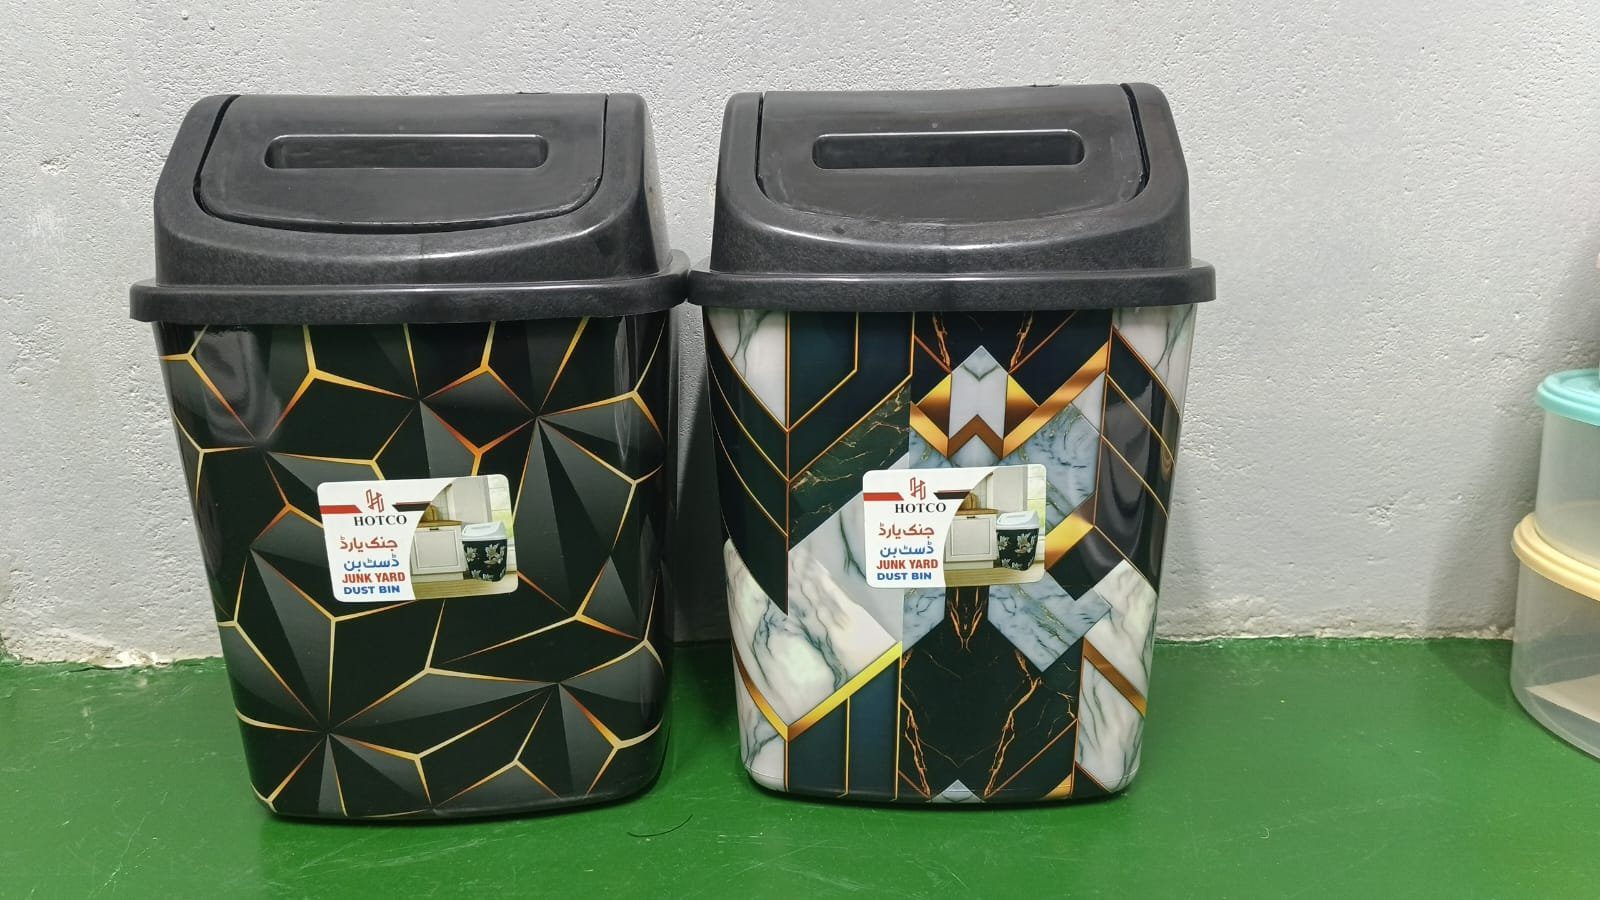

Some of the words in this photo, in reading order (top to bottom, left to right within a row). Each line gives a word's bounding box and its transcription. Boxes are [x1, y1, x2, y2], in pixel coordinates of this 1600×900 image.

[895, 502, 947, 514] HOTCO
[353, 514, 408, 527] HOTCO
[880, 546, 898, 559] بن
[343, 559, 362, 572] بن
[876, 559, 906, 570] JUNK
[909, 558, 939, 569] YARD
[342, 573, 372, 584] JUNK
[375, 571, 406, 583] YARD
[876, 572, 908, 581] DUST
[911, 571, 932, 580] BIN
[343, 586, 376, 595] DUST
[379, 585, 401, 594] BIN
